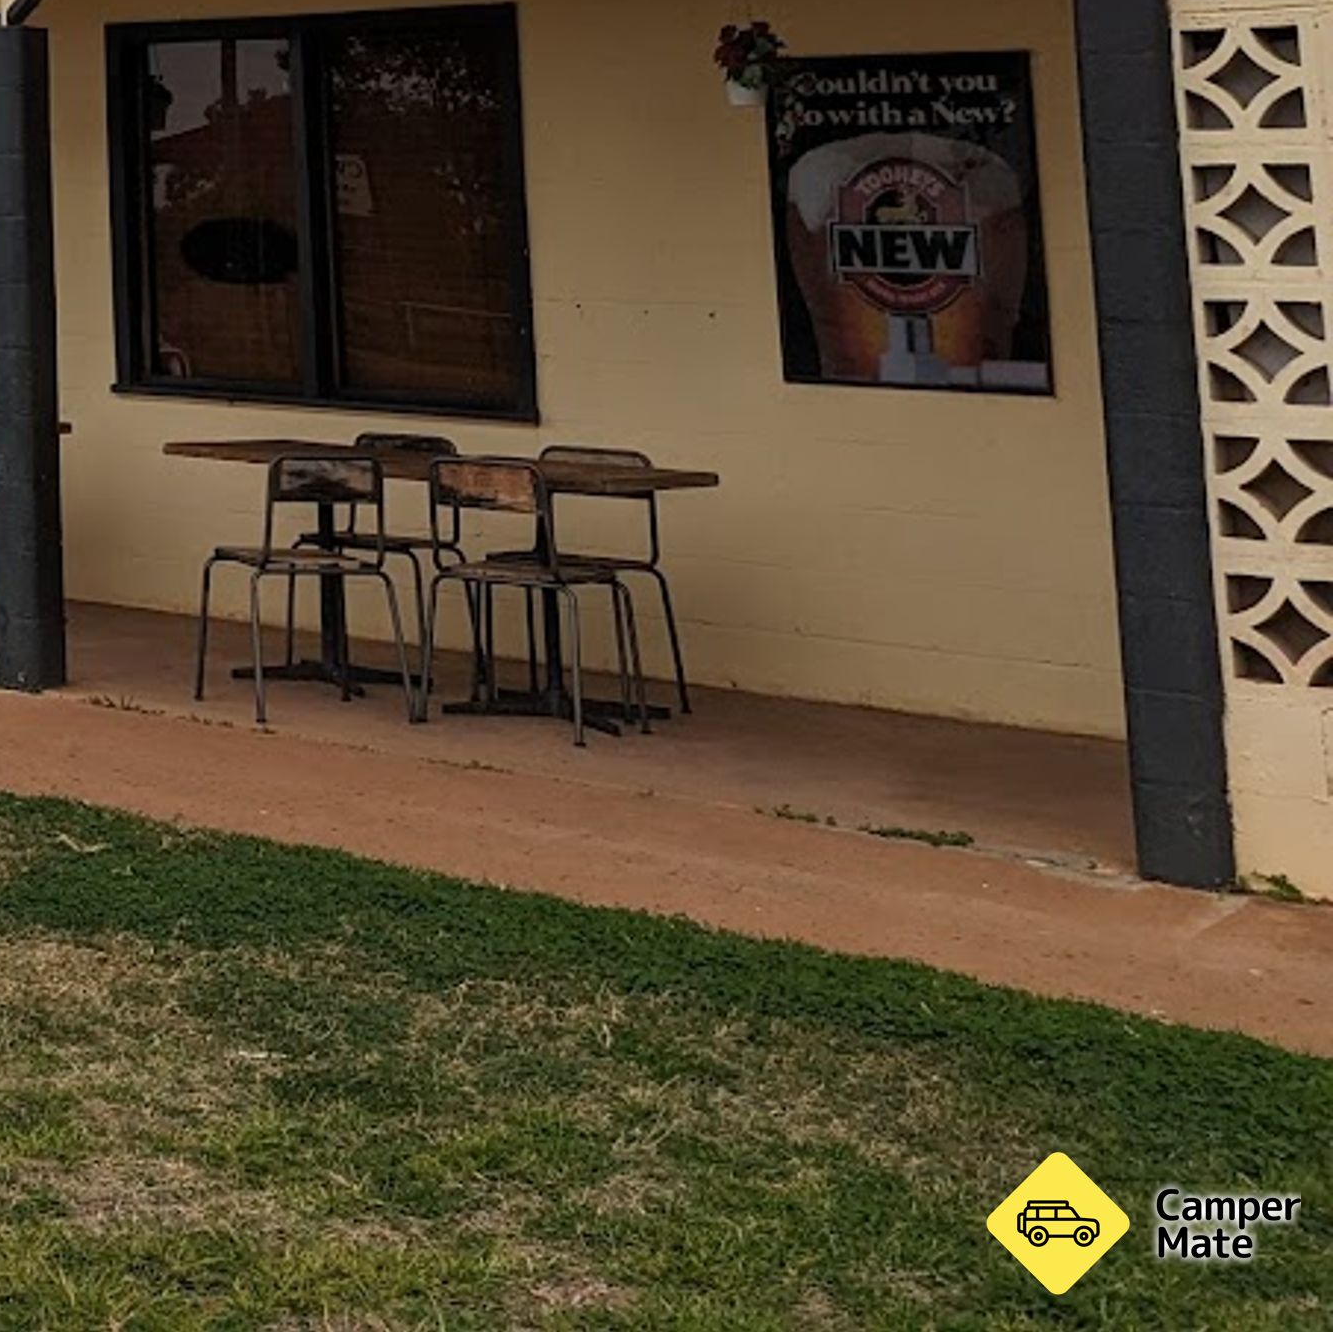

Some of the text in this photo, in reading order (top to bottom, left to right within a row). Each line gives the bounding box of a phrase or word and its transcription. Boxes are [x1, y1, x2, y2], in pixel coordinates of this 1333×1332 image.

[794, 69, 998, 102] Couldn't you
[829, 100, 901, 127] with
[908, 109, 926, 127] a
[930, 98, 1017, 125] New?
[839, 229, 971, 269] NEW
